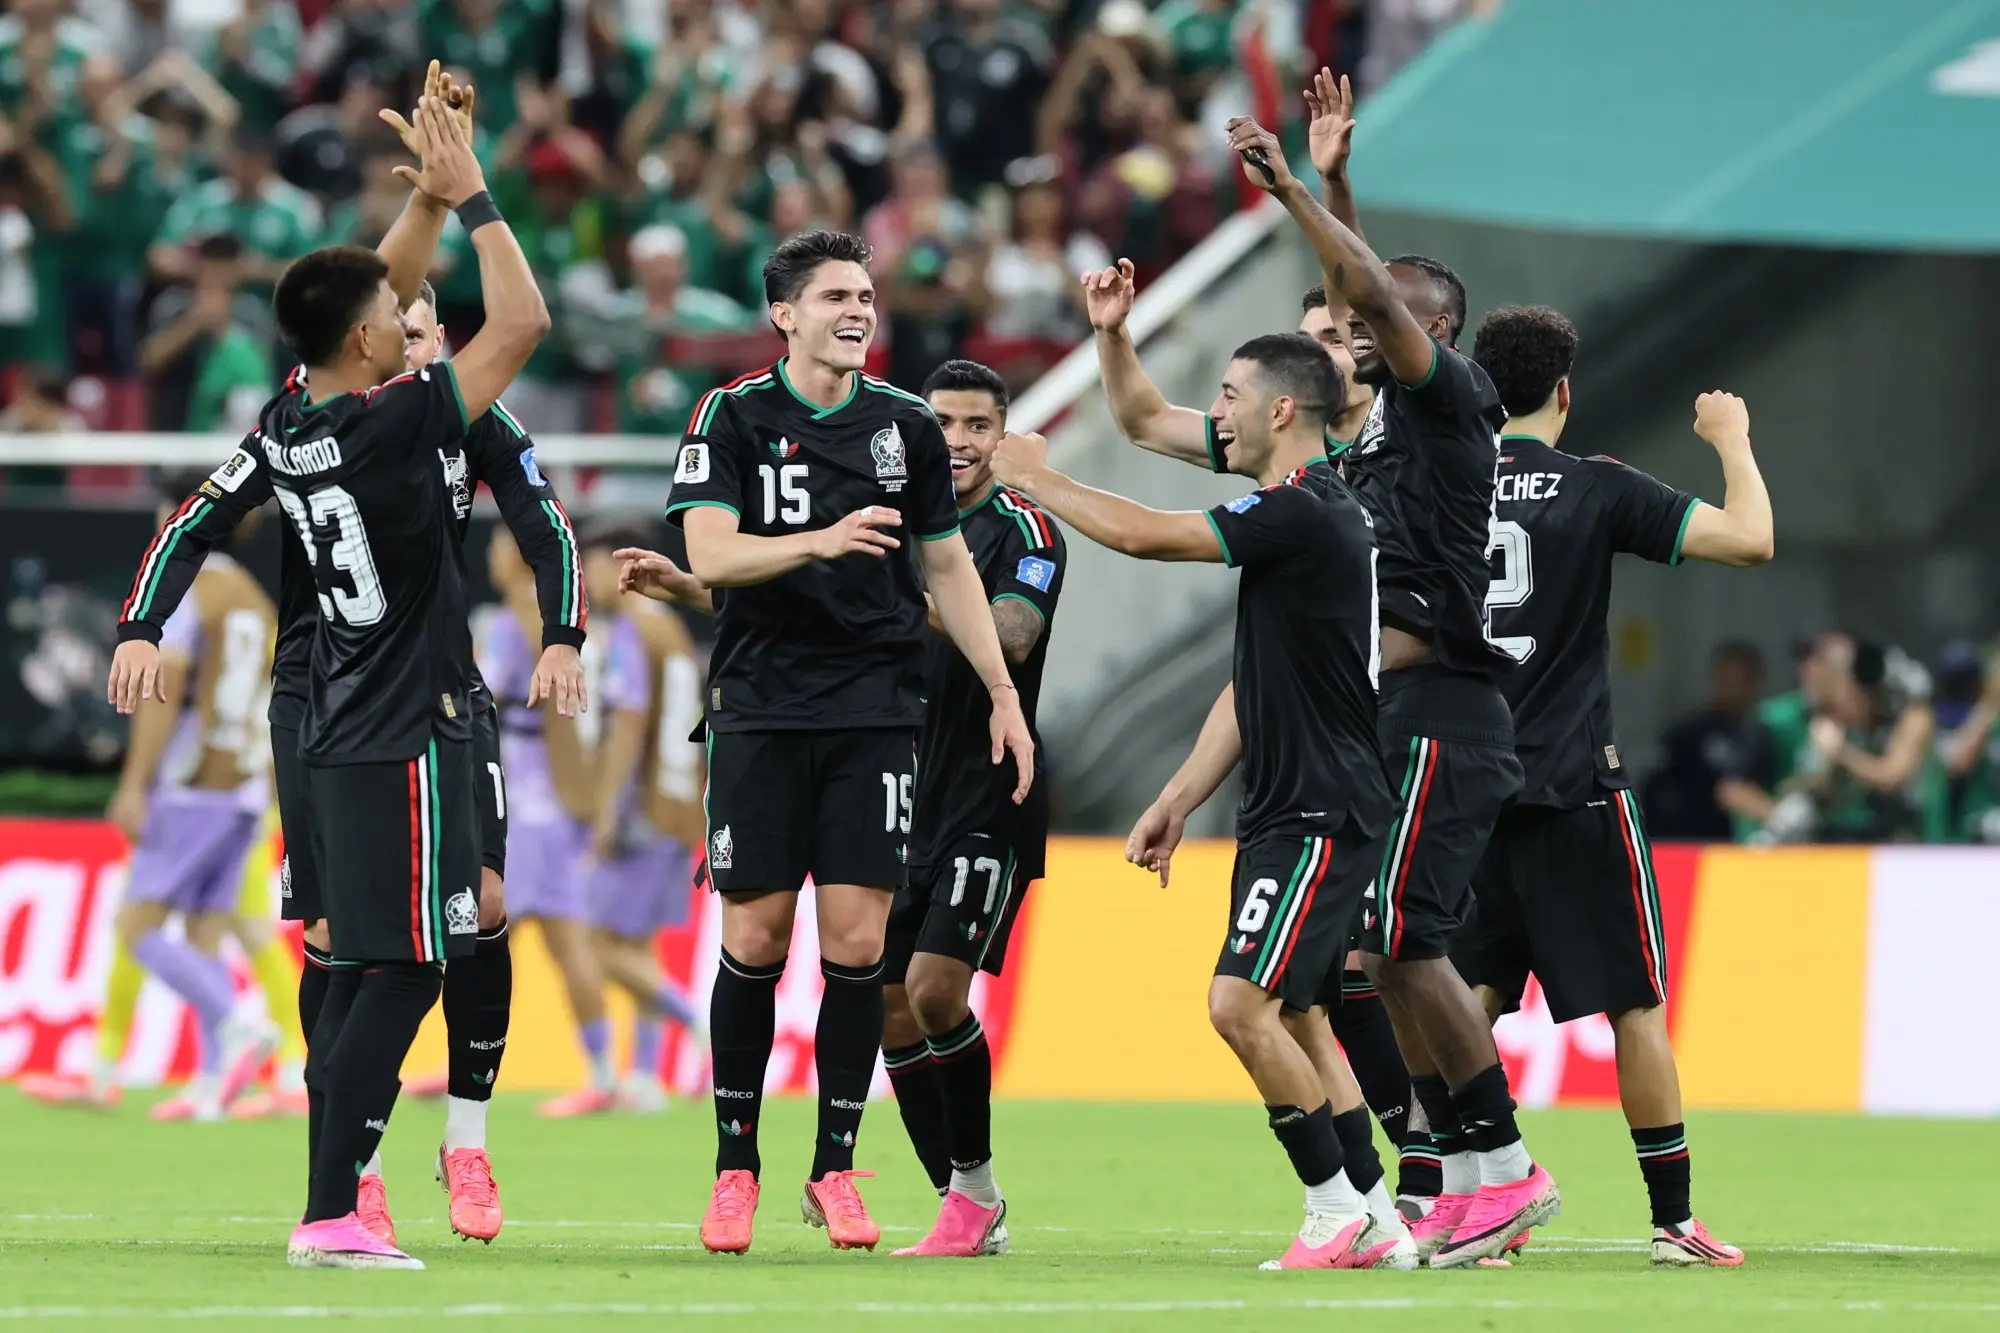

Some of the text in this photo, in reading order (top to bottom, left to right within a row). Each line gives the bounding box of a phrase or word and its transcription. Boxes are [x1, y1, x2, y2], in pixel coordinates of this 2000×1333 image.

[878, 466, 906, 475] MÉXICO
[758, 464, 811, 525] 15
[1497, 473, 1563, 501] CHEZ
[486, 762, 506, 820] 1
[882, 772, 913, 834] 15
[950, 856, 1001, 914] 17
[1236, 878, 1279, 933] 6
[470, 1037, 506, 1050] MÉXIC
[715, 1088, 754, 1099] MÉXICO
[831, 1098, 866, 1110] MÉXIC
[1377, 1105, 1404, 1122] XICO
